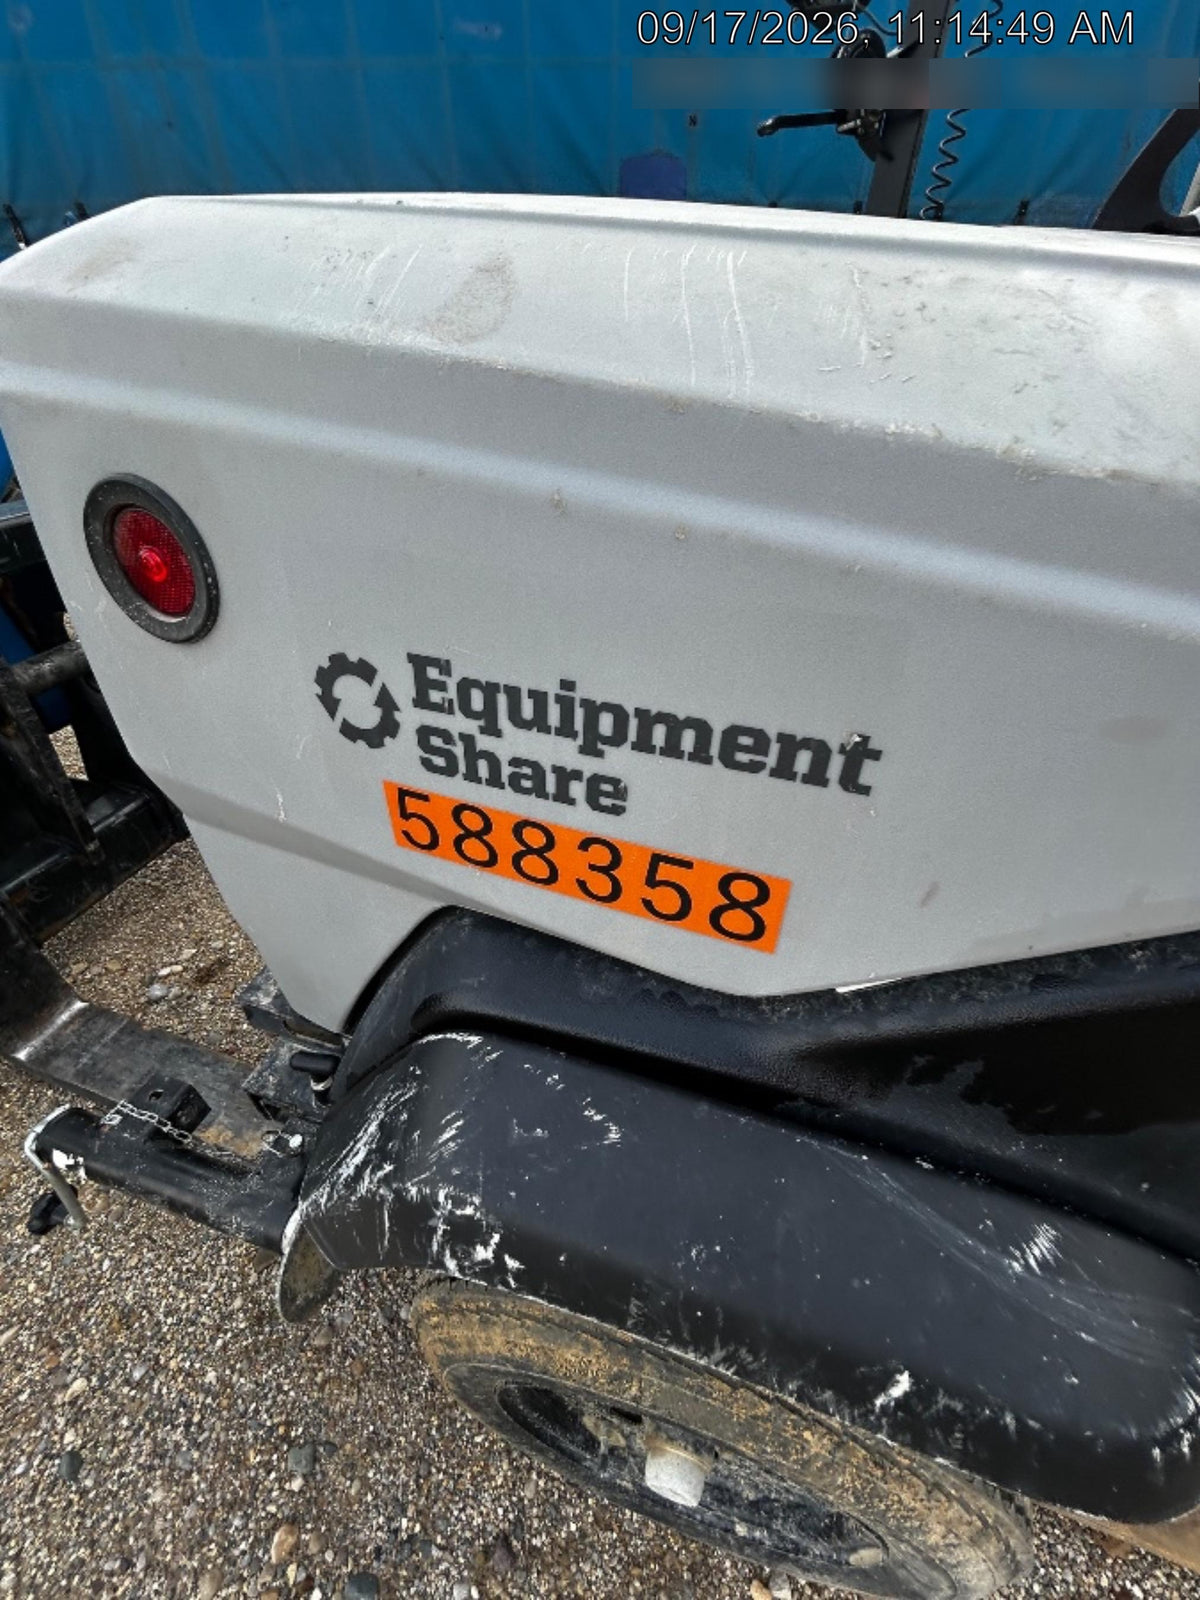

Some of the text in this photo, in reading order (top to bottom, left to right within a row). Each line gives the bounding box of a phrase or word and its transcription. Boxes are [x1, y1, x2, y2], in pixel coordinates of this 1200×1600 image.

[406, 653, 882, 796] Equipment
[415, 725, 627, 816] Share
[397, 787, 771, 943] 588358
